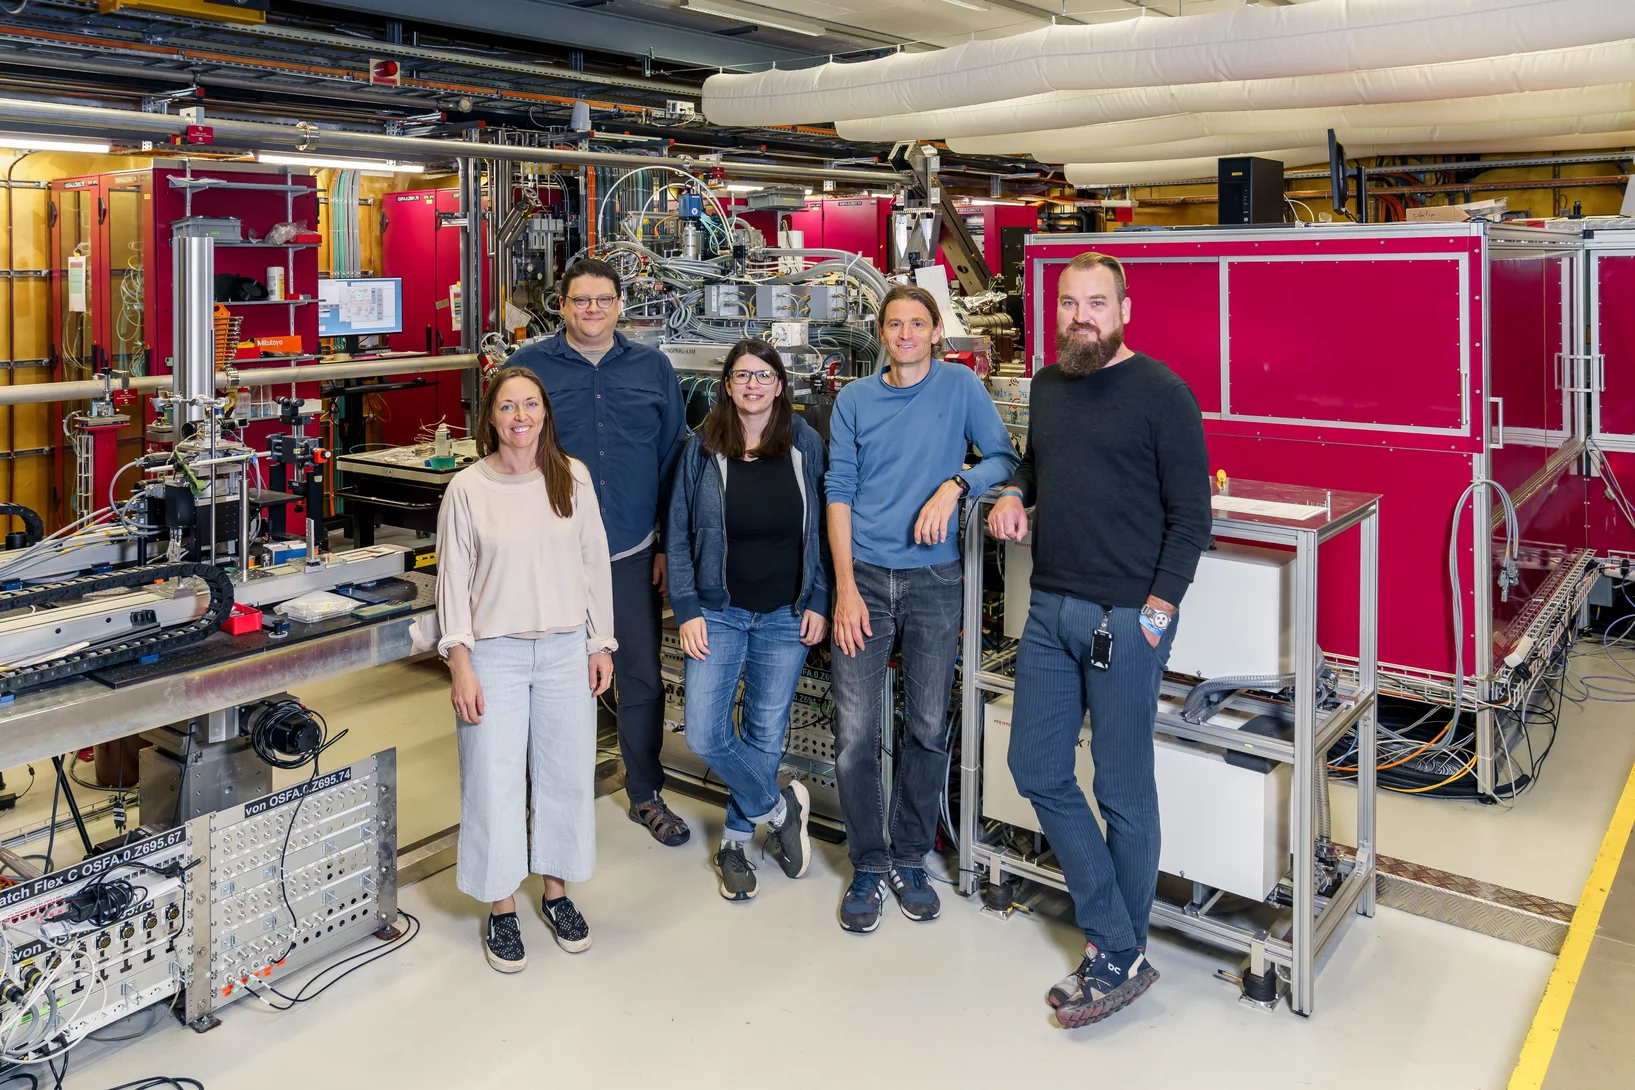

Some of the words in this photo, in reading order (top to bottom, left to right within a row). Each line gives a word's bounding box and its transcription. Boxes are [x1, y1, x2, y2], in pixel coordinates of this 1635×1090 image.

[257, 339, 283, 347] Mitutoyo
[993, 719, 1012, 727] PFEIFFE
[245, 803, 266, 815] von
[0, 887, 30, 907] atch
[34, 876, 63, 894] Flex
[68, 868, 78, 881] C
[82, 831, 182, 876] OSFA.0.Z695.67
[14, 943, 42, 962] von
